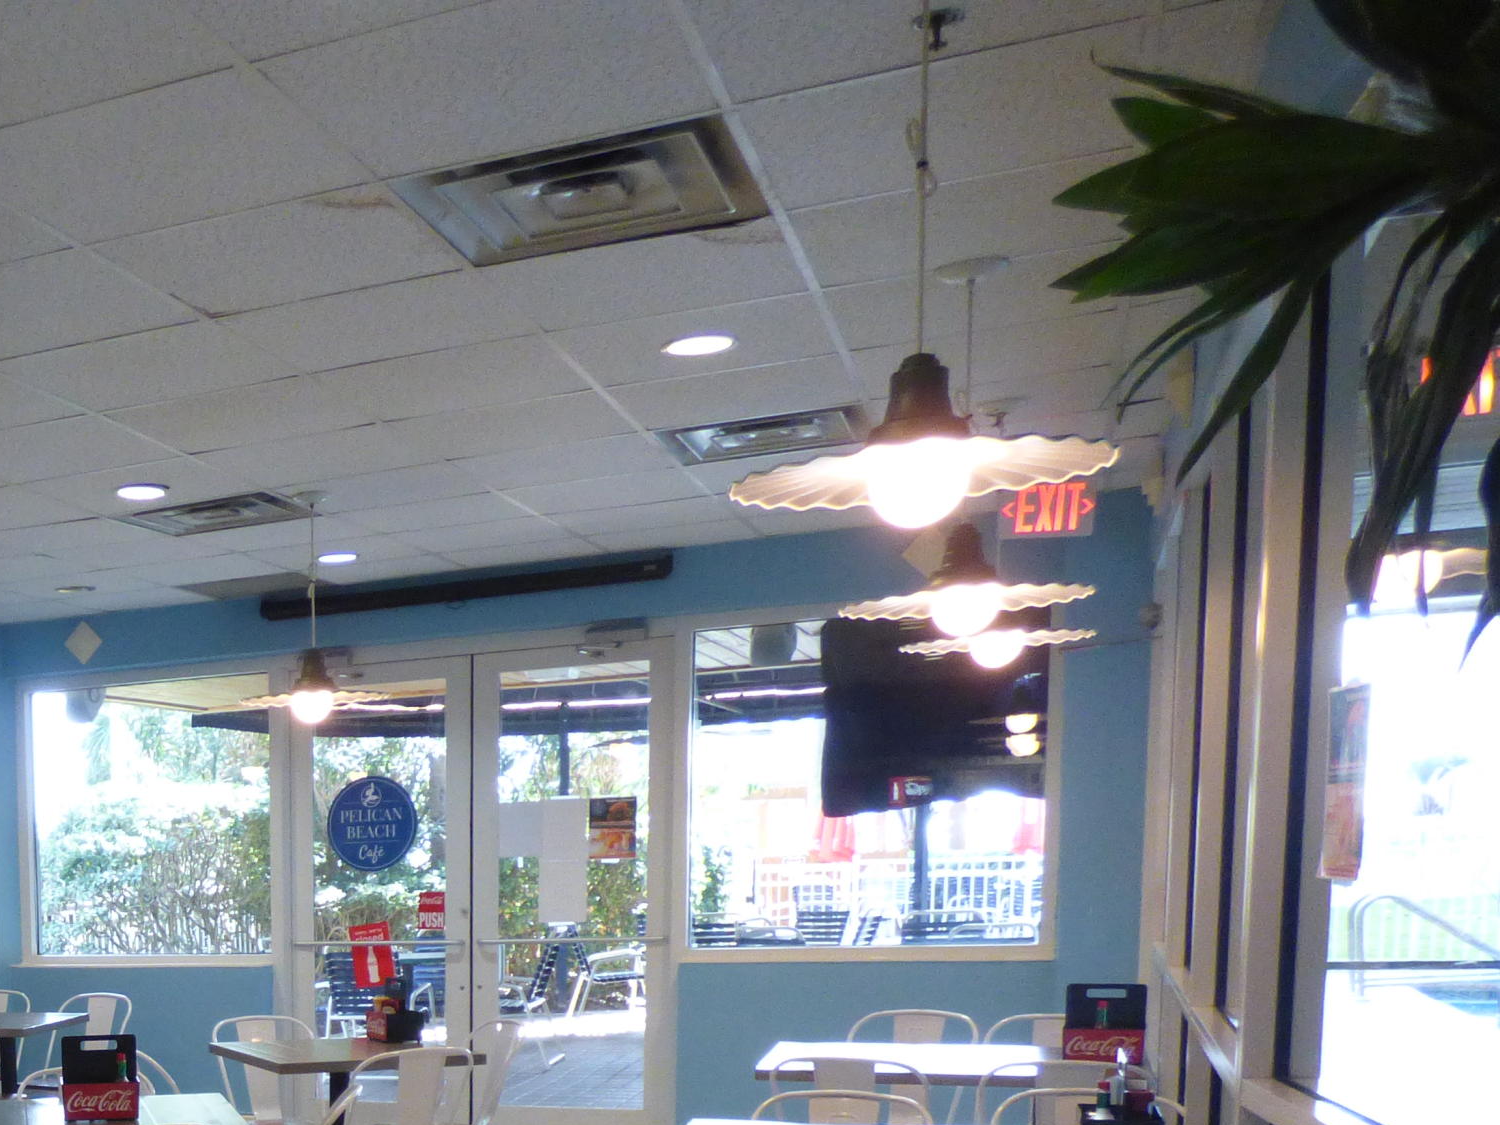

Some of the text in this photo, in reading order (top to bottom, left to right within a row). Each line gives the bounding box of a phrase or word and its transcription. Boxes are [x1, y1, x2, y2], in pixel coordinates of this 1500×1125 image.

[1014, 481, 1086, 534] EXIT
[340, 807, 404, 824] PELICAN
[347, 824, 396, 839] BEACH
[359, 844, 385, 864] Café
[419, 911, 445, 928] PUSH
[67, 1089, 134, 1113] Coca-Cola
